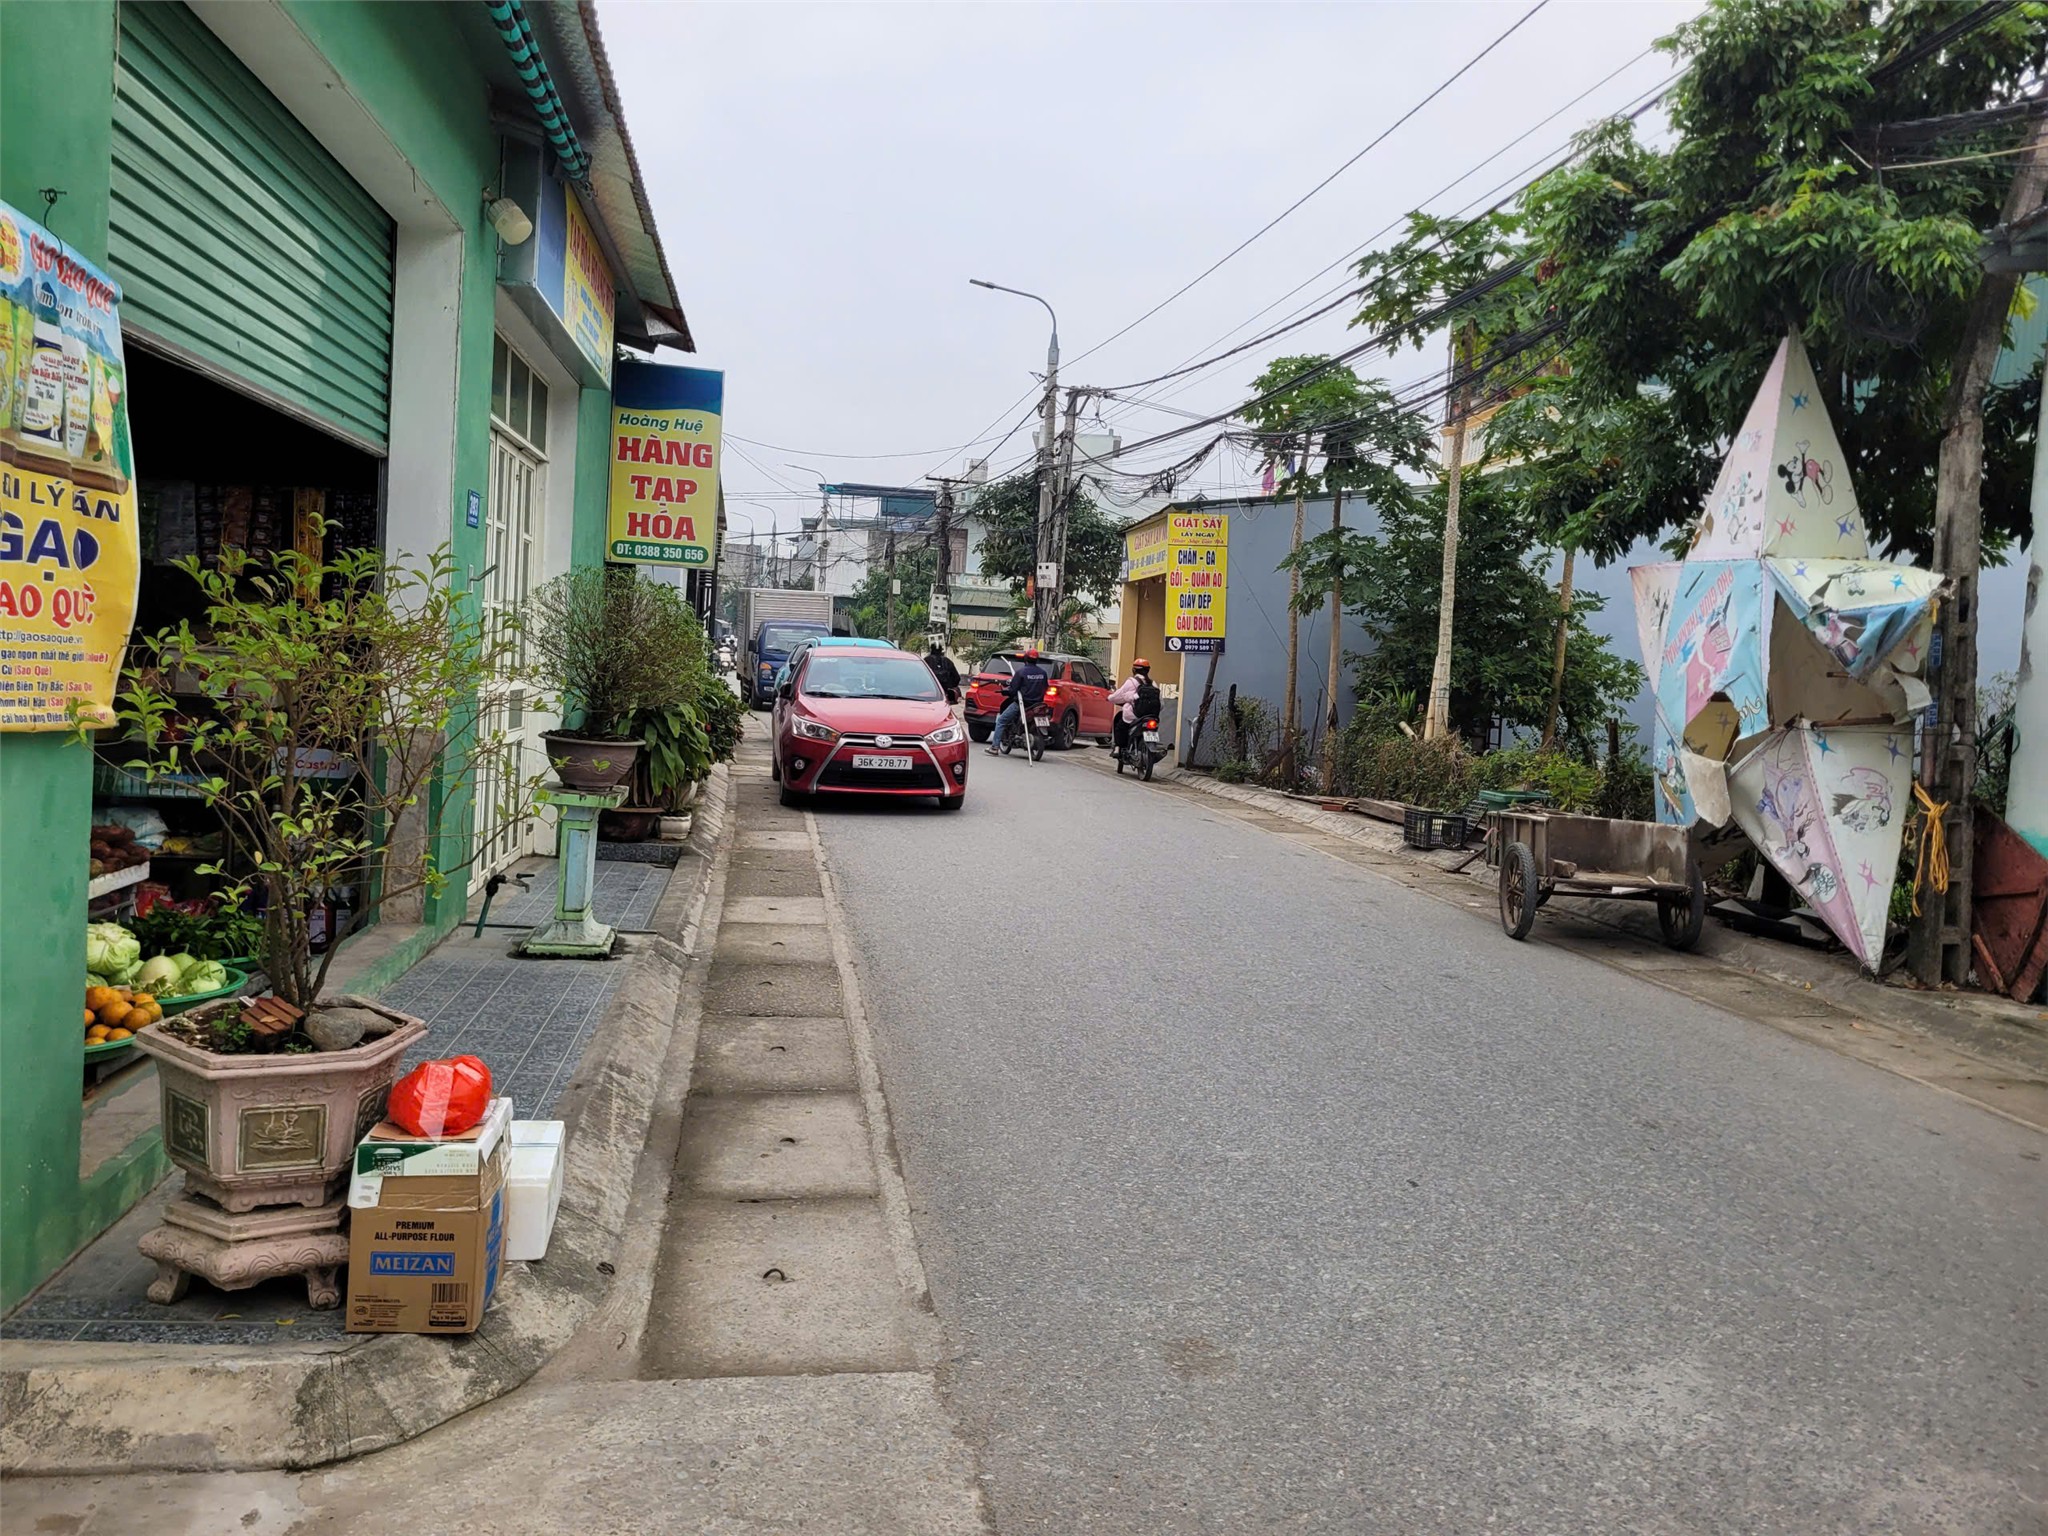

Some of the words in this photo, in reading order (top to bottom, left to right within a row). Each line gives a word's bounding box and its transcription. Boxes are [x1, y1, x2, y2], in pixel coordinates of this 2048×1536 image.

[0, 246, 18, 269] uê
[57, 255, 87, 293] SAO
[86, 277, 115, 315] QUÊ
[619, 413, 669, 431] Hoàng
[674, 418, 704, 435] Huệ
[618, 434, 713, 469] HÀNG
[31, 481, 65, 507] LÝ
[630, 475, 698, 506] TẠP
[627, 510, 696, 541] HÓA
[0, 510, 99, 582] GẠO
[616, 543, 632, 555] ĐT:
[634, 545, 660, 557] 0388
[663, 547, 682, 559] 350
[685, 549, 704, 561] 656
[1206, 550, 1216, 565] GA
[1170, 566, 1183, 586] GỐI
[1192, 567, 1210, 587] QUẦN
[1213, 569, 1222, 587] ÁO
[0, 581, 42, 618] AO
[1198, 591, 1212, 609] DÉP
[1177, 610, 1191, 630] GẤU
[1194, 613, 1213, 631] BÔNG
[18, 650, 37, 661] ngon
[15, 665, 31, 676] (Sao
[858, 757, 908, 768] 36K-278.77
[396, 1221, 435, 1230] PREMIUM
[375, 1232, 428, 1241] ALL-PURPOSE
[430, 1233, 455, 1242] FLOUR
[375, 1257, 451, 1271] MEIZAN
